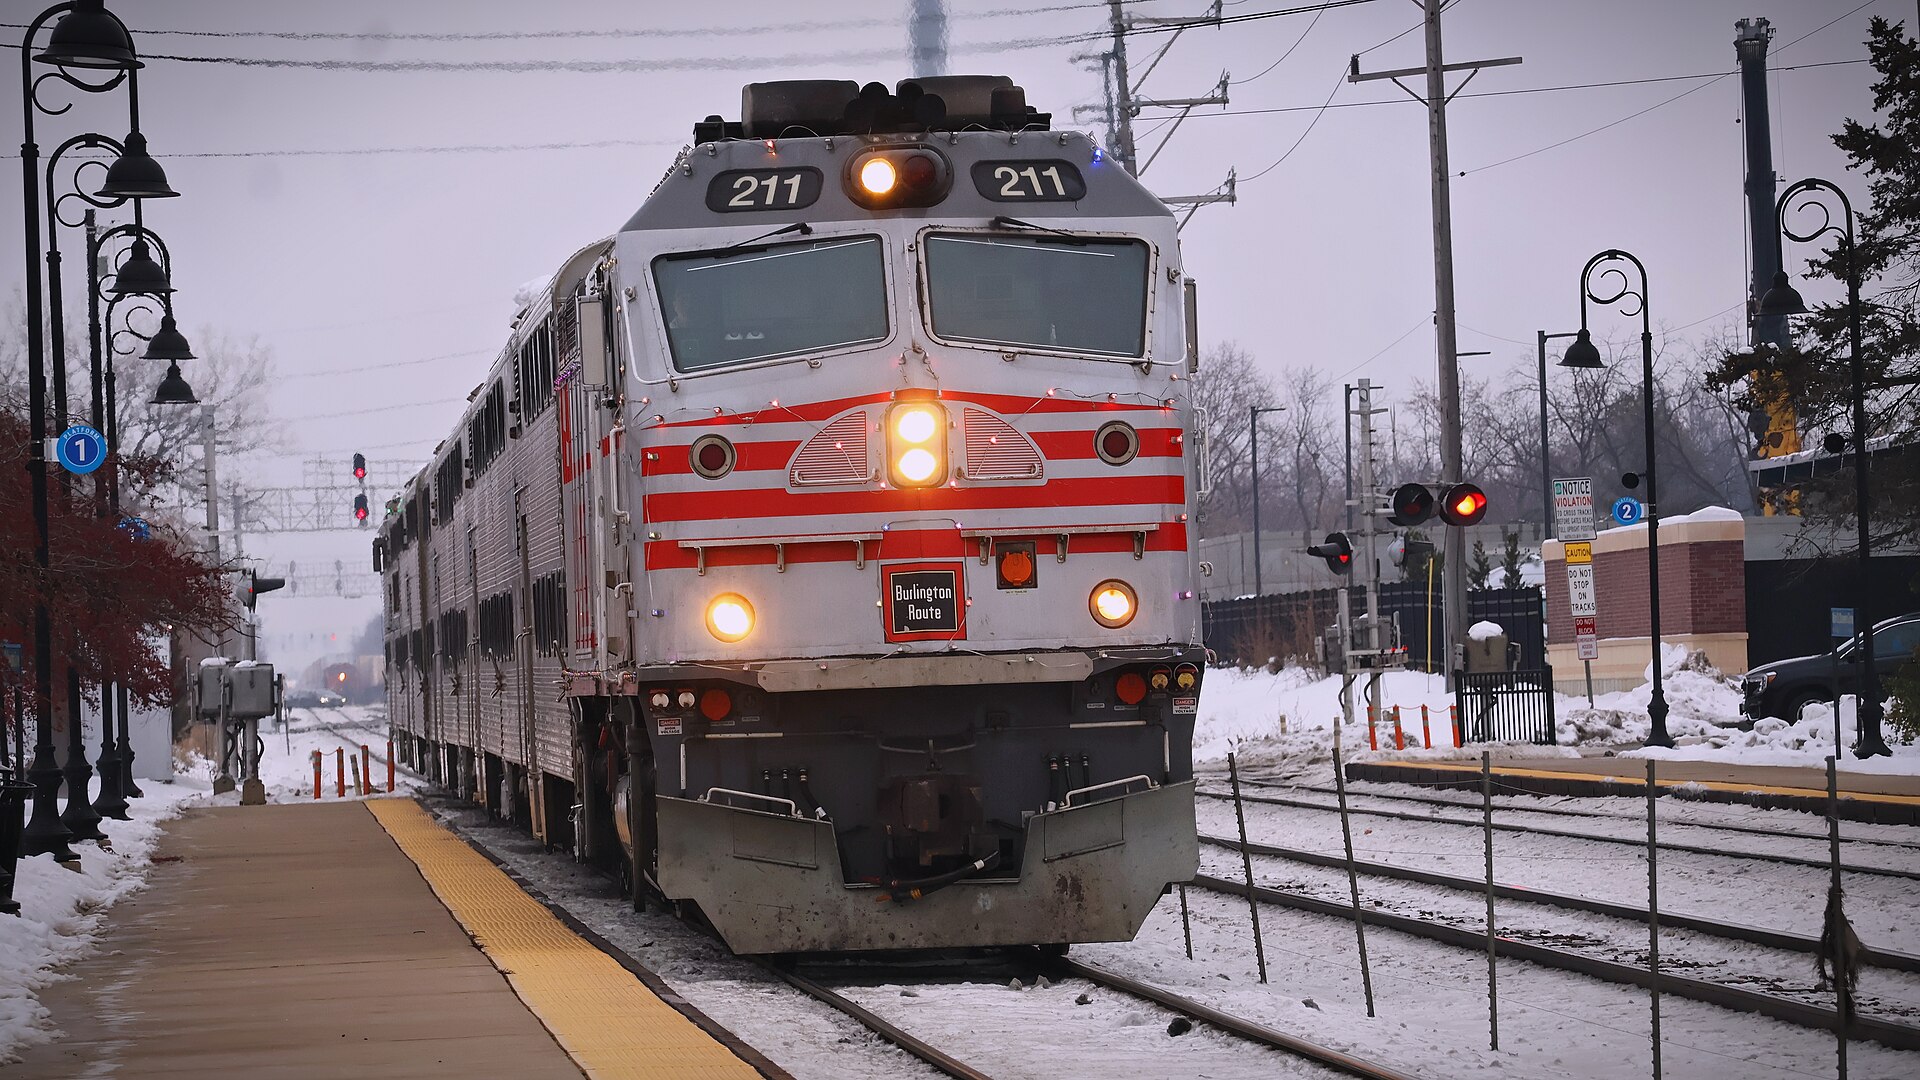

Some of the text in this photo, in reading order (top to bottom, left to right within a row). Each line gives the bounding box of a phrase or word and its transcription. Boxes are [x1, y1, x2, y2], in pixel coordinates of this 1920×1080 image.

[994, 166, 1066, 196] 211
[728, 174, 802, 207] 211
[63, 427, 100, 440] PLATFORM
[75, 438, 86, 462] 1
[1562, 481, 1590, 495] NOTICE
[1555, 496, 1593, 507] VIOLATION
[1622, 504, 1632, 519] 2
[1566, 549, 1591, 558] CAUTION
[1569, 569, 1591, 578] DO NOT
[1573, 580, 1589, 589] STOP
[895, 583, 953, 602] Burlington
[1578, 592, 1587, 600] ON
[908, 604, 942, 620] Route
[1571, 603, 1596, 611] TRACKS
[1578, 627, 1594, 635] BLOCK
